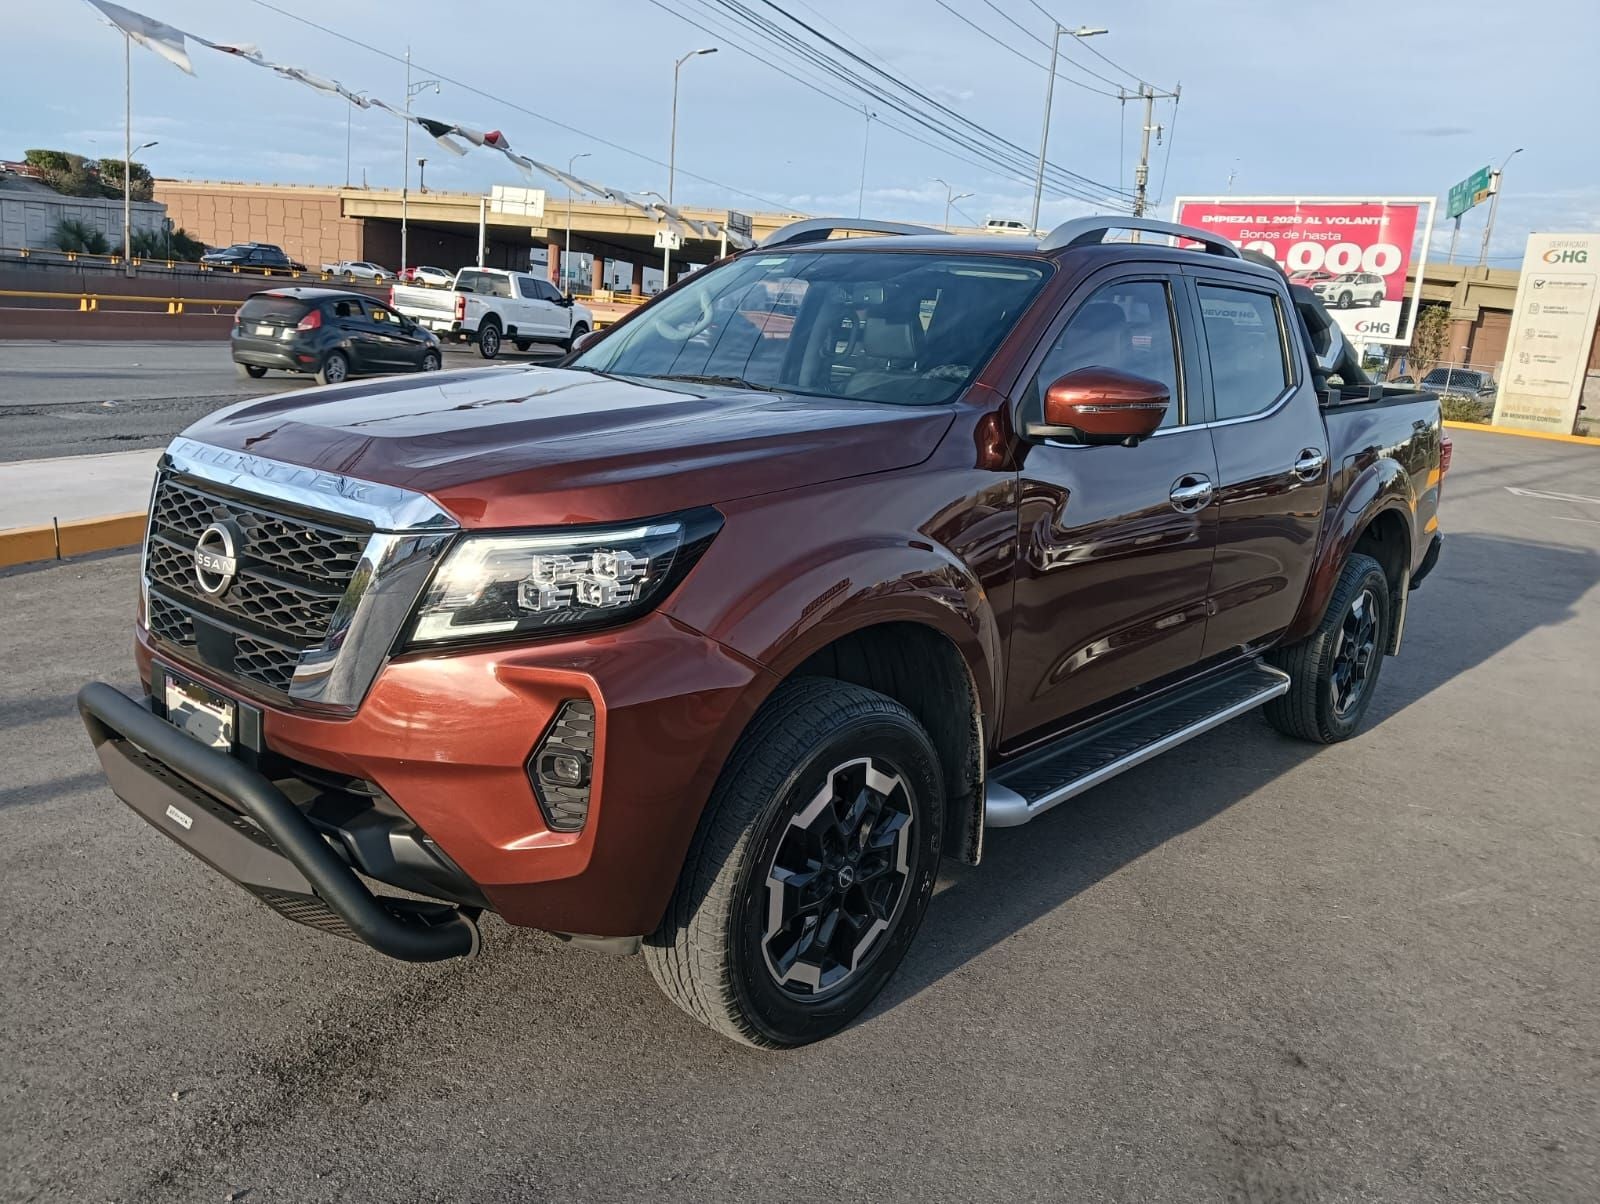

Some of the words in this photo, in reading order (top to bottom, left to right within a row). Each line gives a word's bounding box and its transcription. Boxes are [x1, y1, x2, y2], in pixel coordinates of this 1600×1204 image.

[1201, 215, 1254, 224] EMPIEZA
[1255, 216, 1271, 224] EL
[1304, 217, 1323, 225] AL
[1325, 217, 1391, 226] VOLANTE
[1239, 229, 1280, 239] Bonos
[1282, 230, 1300, 240] de
[1302, 230, 1342, 241] hasta
[1561, 250, 1588, 264] HG
[1370, 321, 1391, 334] HG
[176, 441, 378, 500] FRONTIER
[197, 552, 235, 572] SSAN
